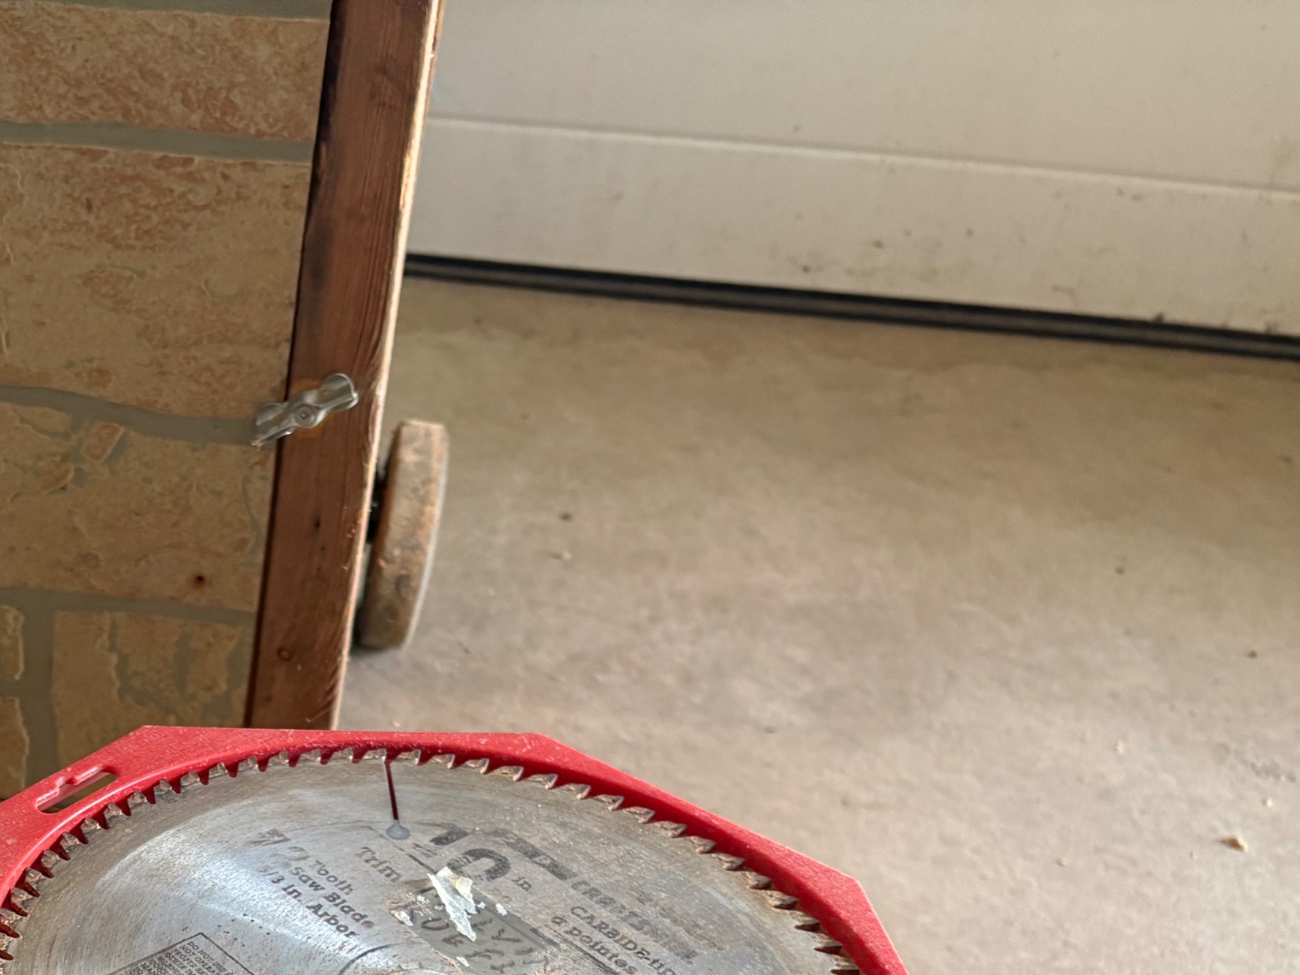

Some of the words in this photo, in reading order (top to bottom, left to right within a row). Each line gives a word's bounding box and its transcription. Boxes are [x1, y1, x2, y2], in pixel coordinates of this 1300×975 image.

[303, 859, 361, 896] Tooth
[349, 845, 411, 883] Trim
[285, 865, 330, 893] Saw
[320, 891, 381, 930] Blade
[303, 900, 362, 939] Arbor
[562, 925, 644, 975] pointes
